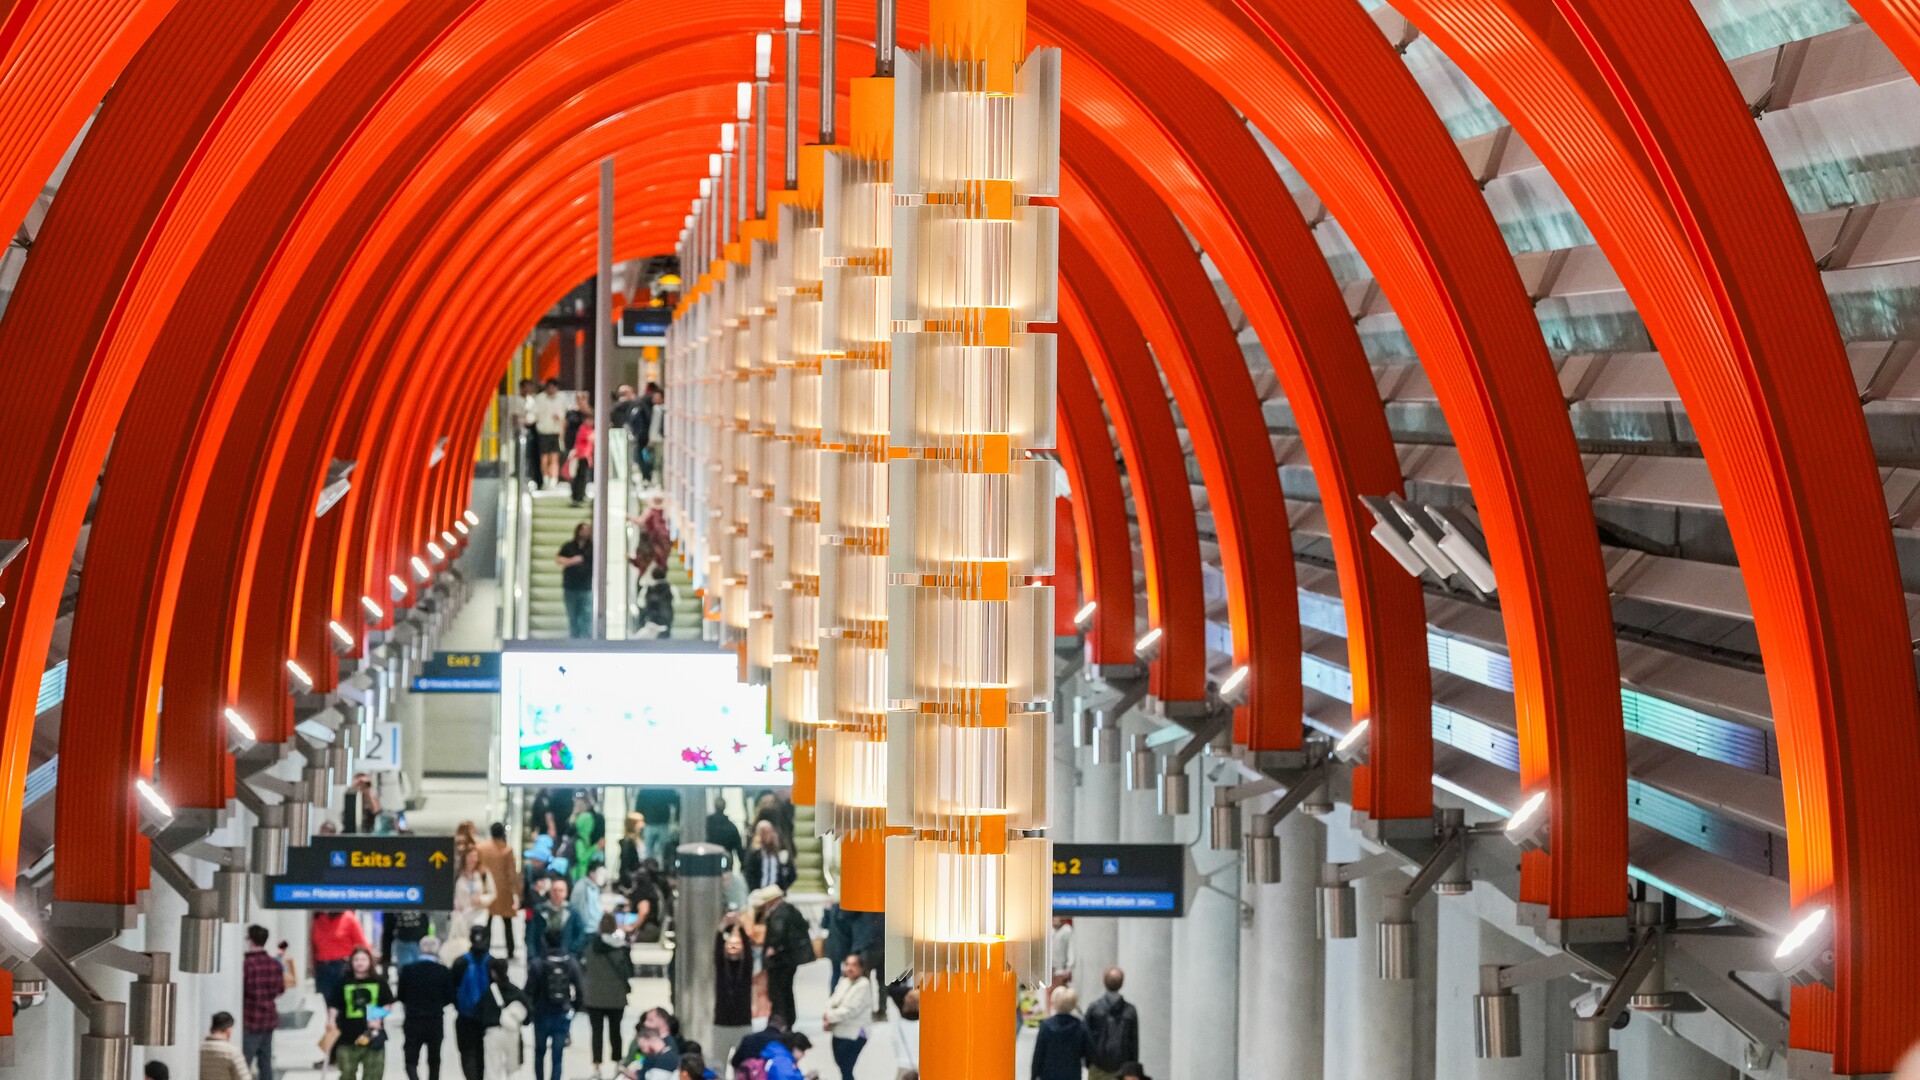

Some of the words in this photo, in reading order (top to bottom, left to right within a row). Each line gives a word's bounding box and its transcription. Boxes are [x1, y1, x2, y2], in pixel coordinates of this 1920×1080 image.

[447, 655, 470, 667] Exit
[366, 732, 382, 759] 2
[351, 851, 392, 867] Exits
[395, 851, 406, 867] 2
[1069, 858, 1081, 874] 2
[347, 889, 372, 898] Street
[375, 889, 404, 898] Station
[1078, 896, 1104, 906] Street
[1105, 896, 1135, 906] Station
